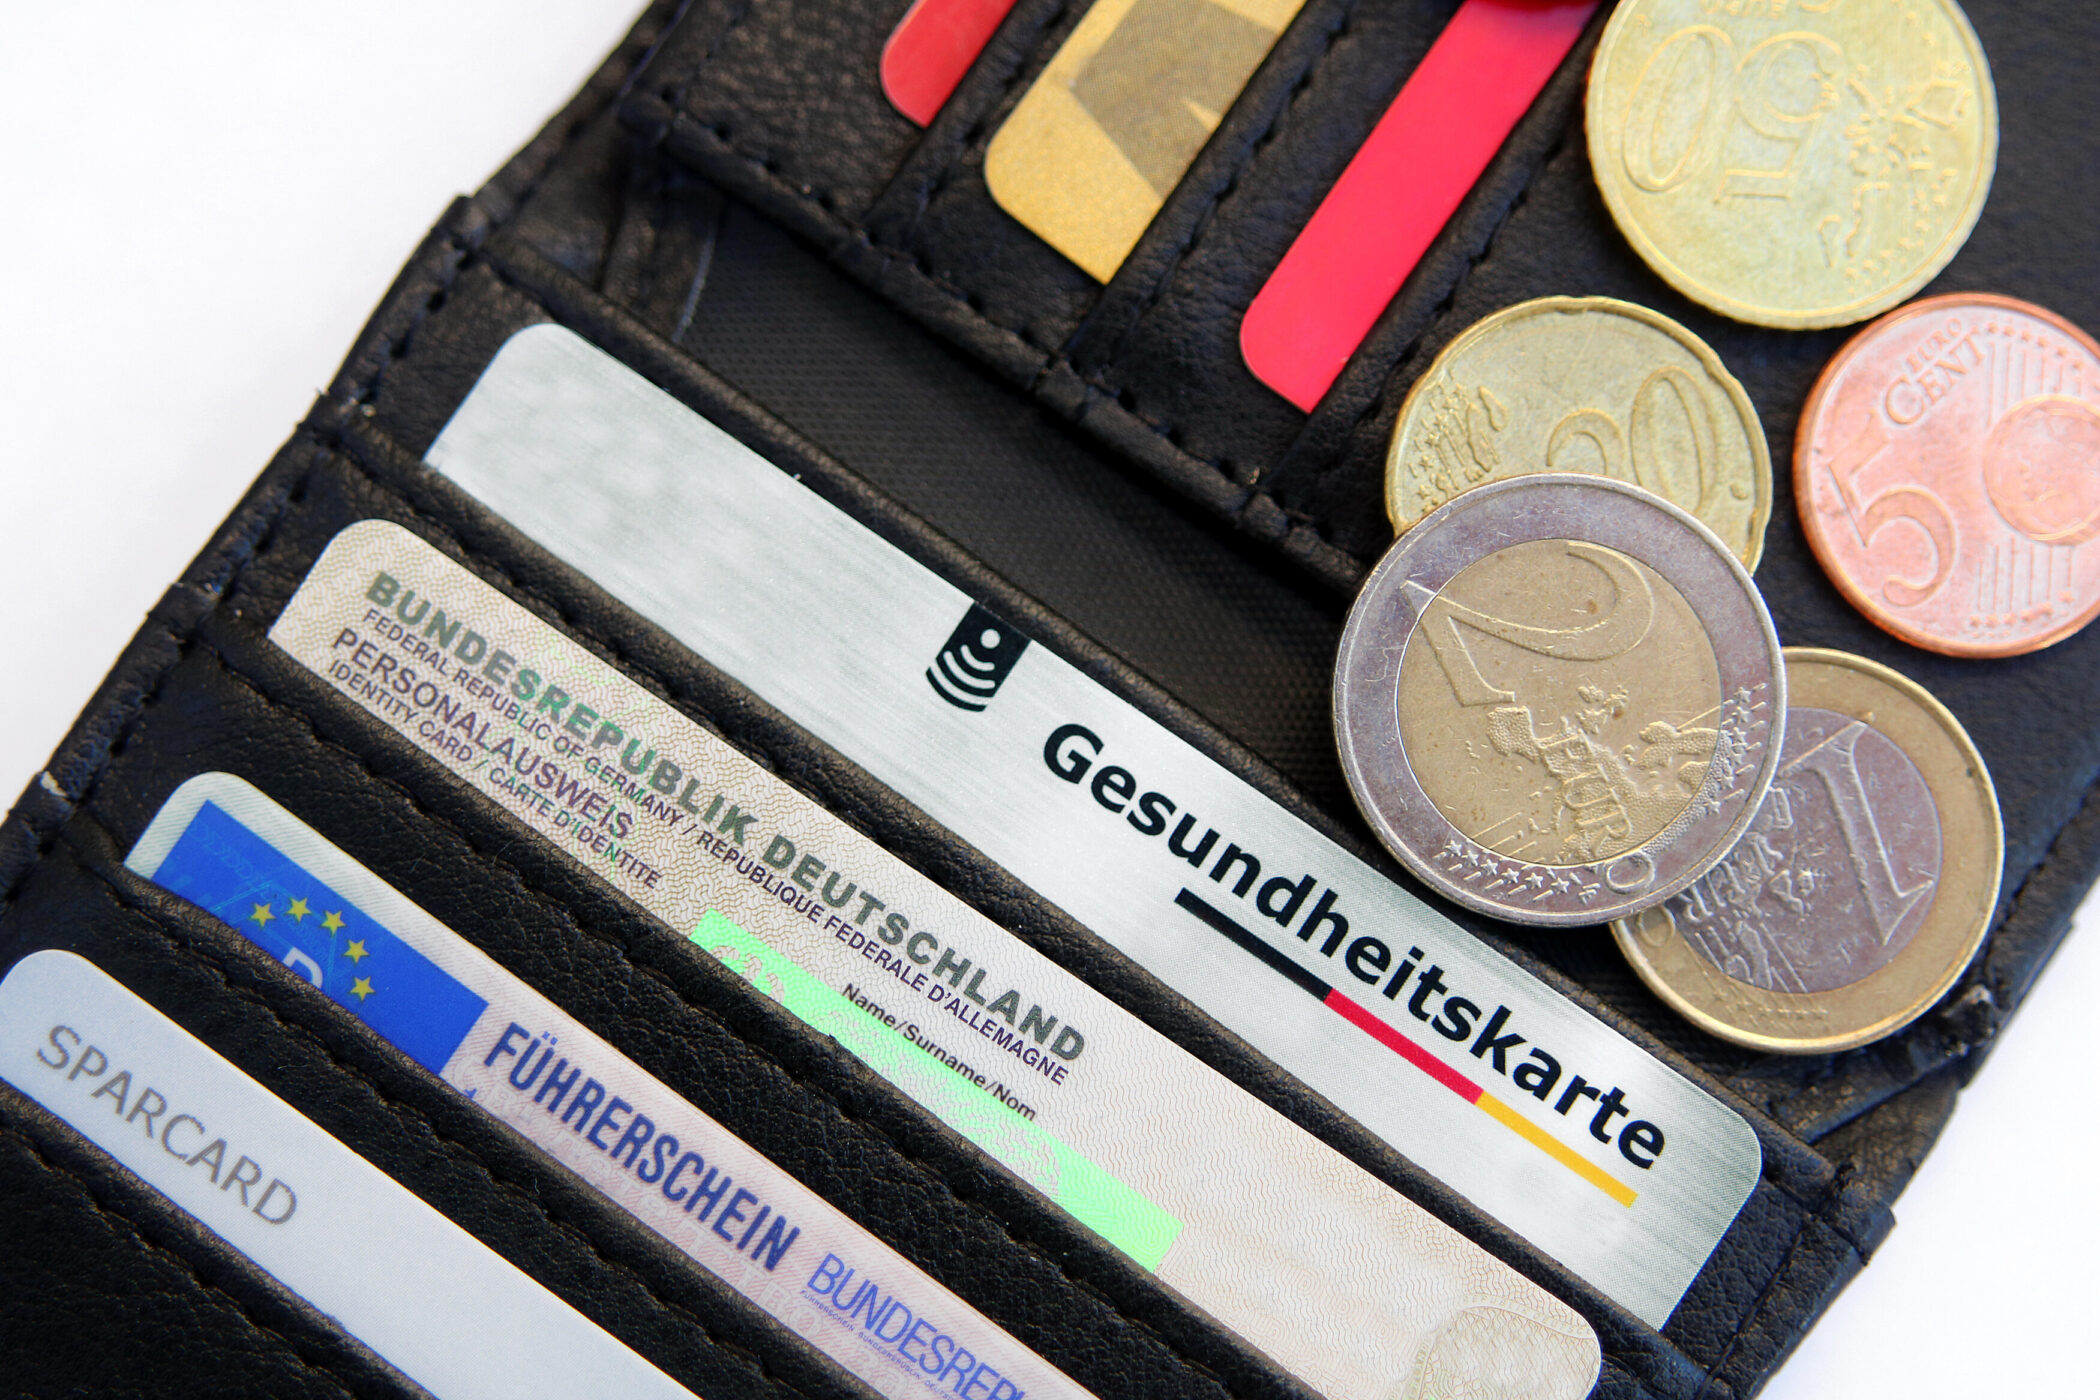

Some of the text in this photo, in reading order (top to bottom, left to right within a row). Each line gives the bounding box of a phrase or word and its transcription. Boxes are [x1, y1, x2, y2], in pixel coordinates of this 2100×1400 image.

[1828, 409, 1958, 608] 5
[1400, 540, 1656, 708] 2
[328, 659, 420, 726] IDENTITY
[418, 719, 474, 762] CARD
[489, 766, 553, 818] CARTE
[332, 627, 635, 839] PERSONALAUSWEIS
[362, 608, 449, 676] FEDERAL
[452, 667, 555, 742] REPUBLIC
[554, 734, 586, 761] OF
[584, 756, 687, 830] GERMANY
[696, 831, 826, 925] REPUBLIQUE
[823, 914, 927, 993] FEDERALE
[365, 571, 1086, 1062] BUNDESREPUBLIK DEUTSCHLAND
[1778, 711, 1935, 948] 1
[842, 983, 1037, 1122] Name/Surname/Nom
[1042, 723, 1666, 1170] Gesundheitskarte
[35, 1024, 298, 1227] SPARCARD
[483, 1022, 801, 1273] FÜHRERSCHEIN
